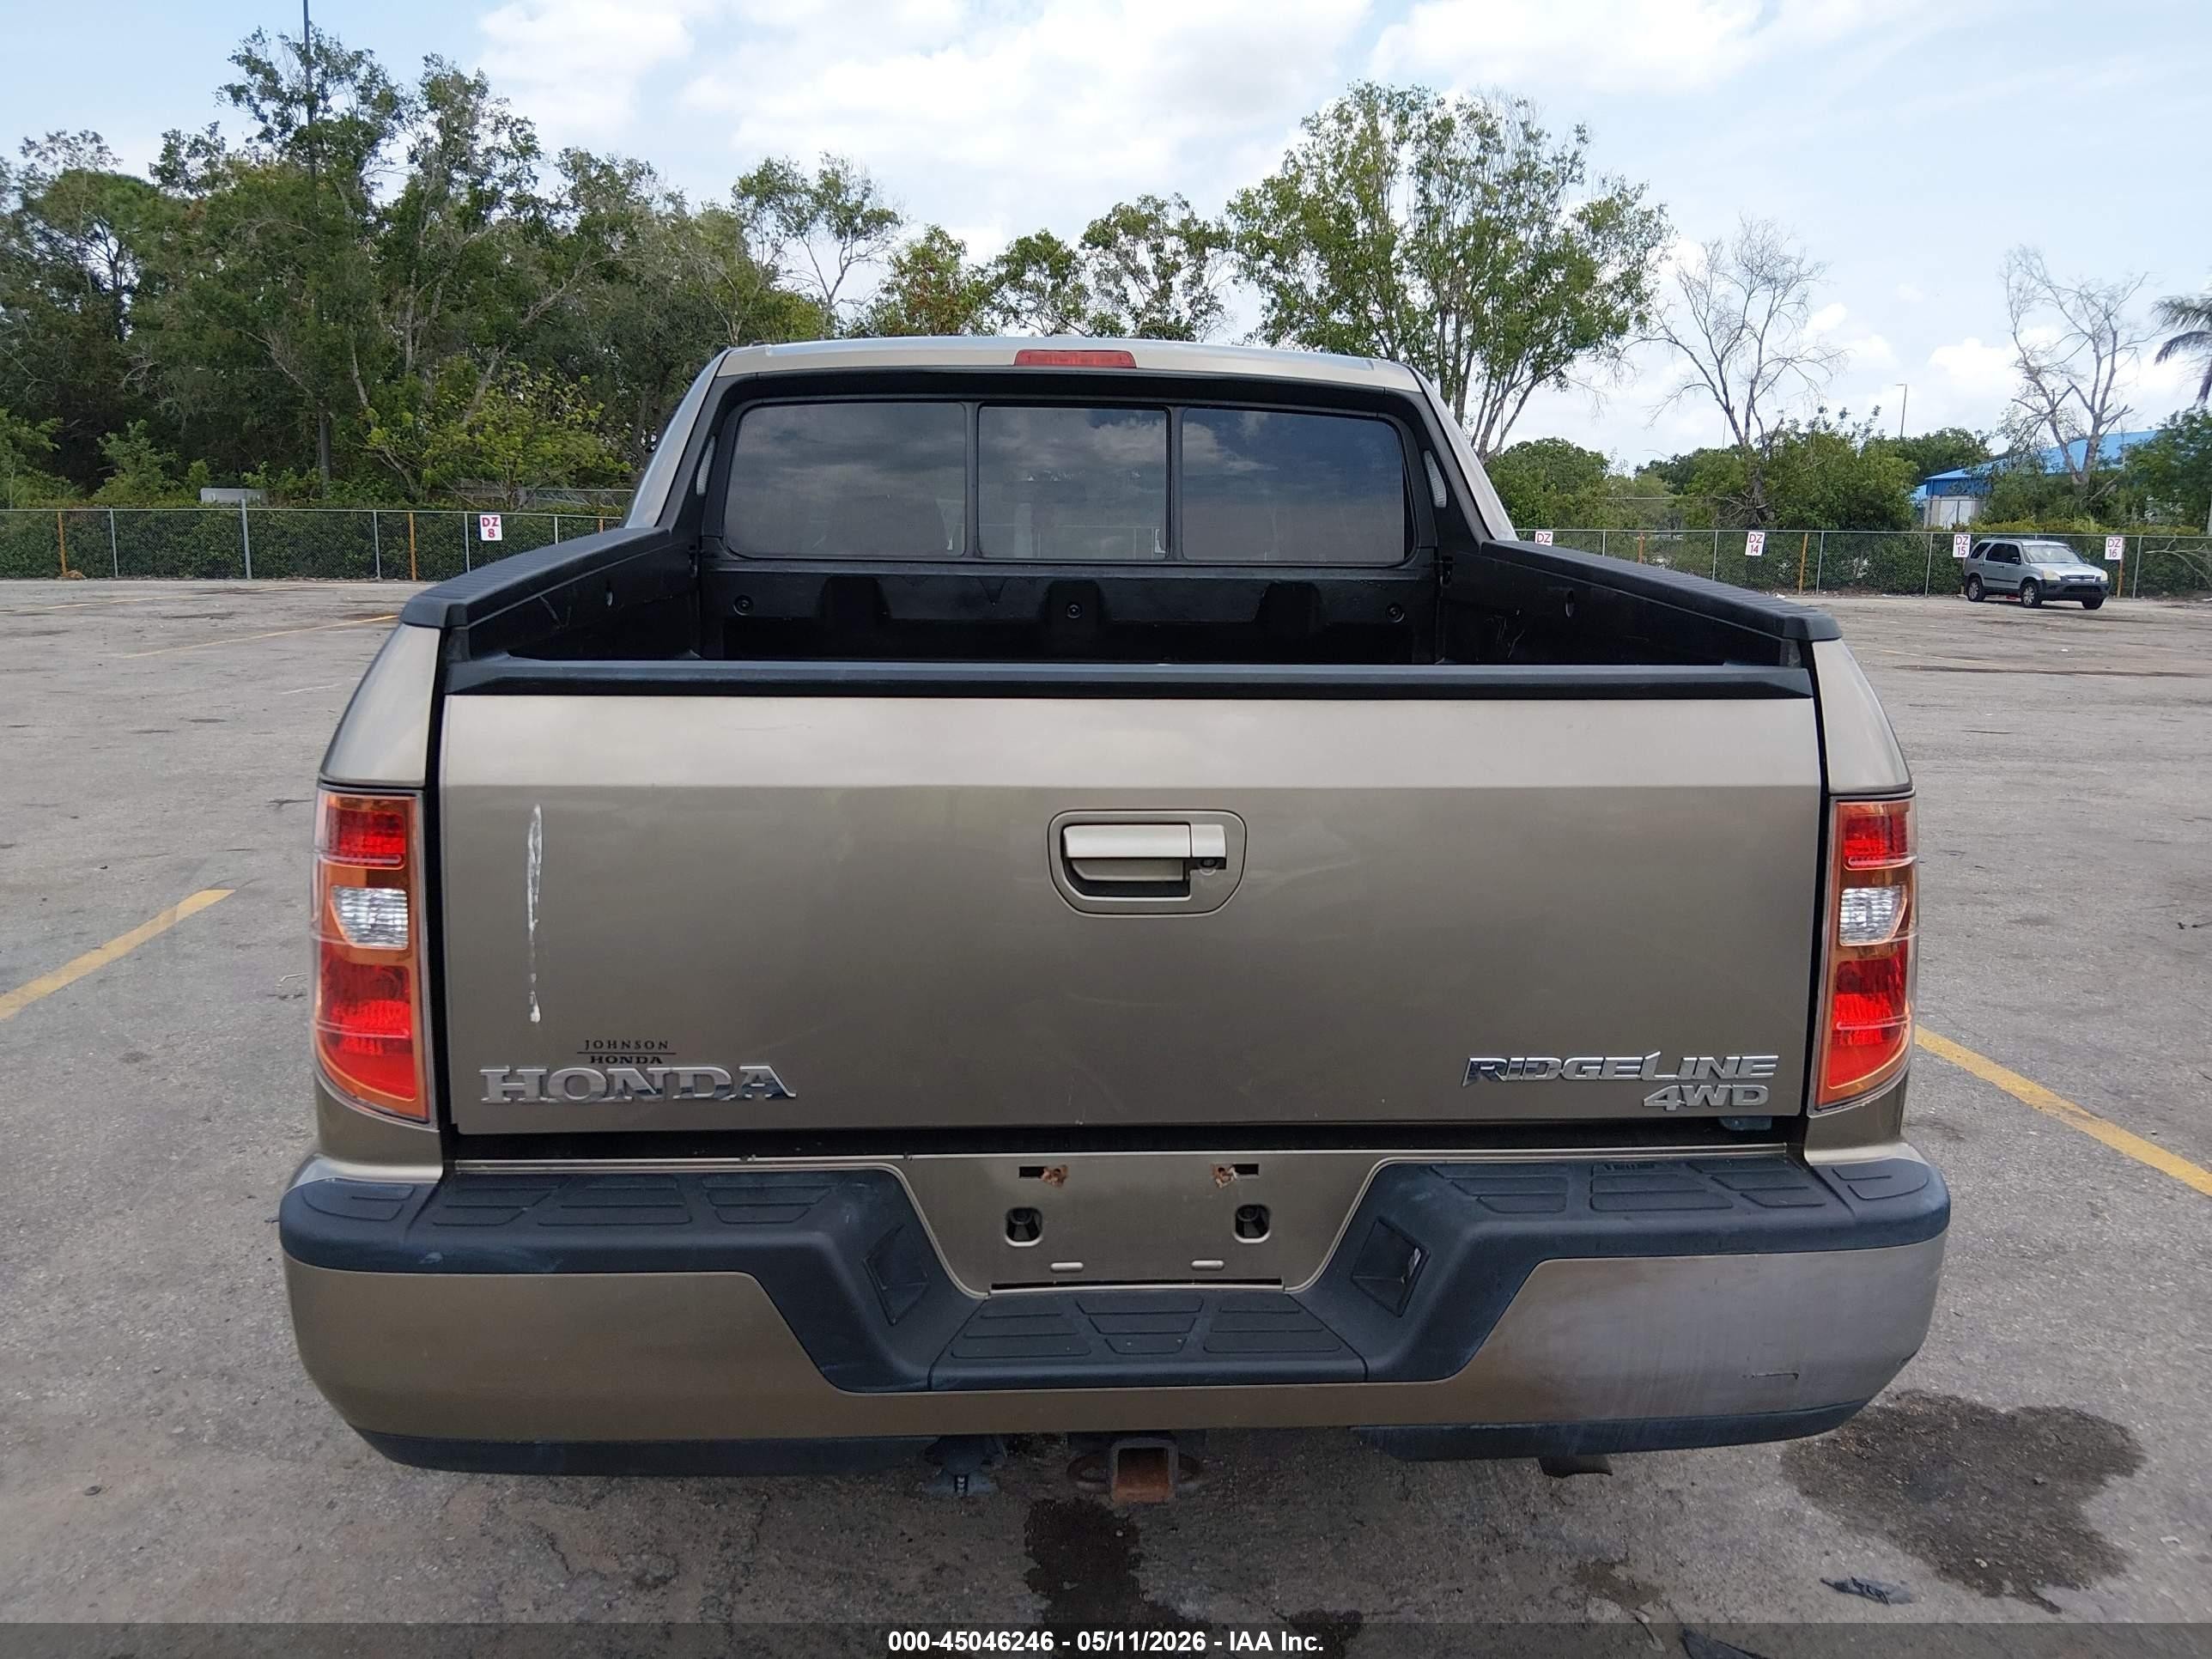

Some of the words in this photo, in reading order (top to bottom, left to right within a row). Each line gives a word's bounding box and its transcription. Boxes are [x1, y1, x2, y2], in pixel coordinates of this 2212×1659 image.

[482, 517, 499, 527] DZ
[488, 528, 495, 538] 8
[1536, 532, 1552, 543] DZ
[1749, 533, 1763, 543] DZ
[1955, 536, 1969, 545] DZ
[2107, 538, 2121, 548] DZ
[1750, 544, 1759, 554] 14
[1957, 546, 1966, 556] 15
[2109, 549, 2117, 558] 16
[584, 1040, 669, 1050] JOHNSON
[590, 1055, 664, 1065] HONDA
[1462, 1050, 1779, 1087] RIDGELINE
[479, 1066, 797, 1103] HONDA
[1643, 1084, 1770, 1111] 4WD
